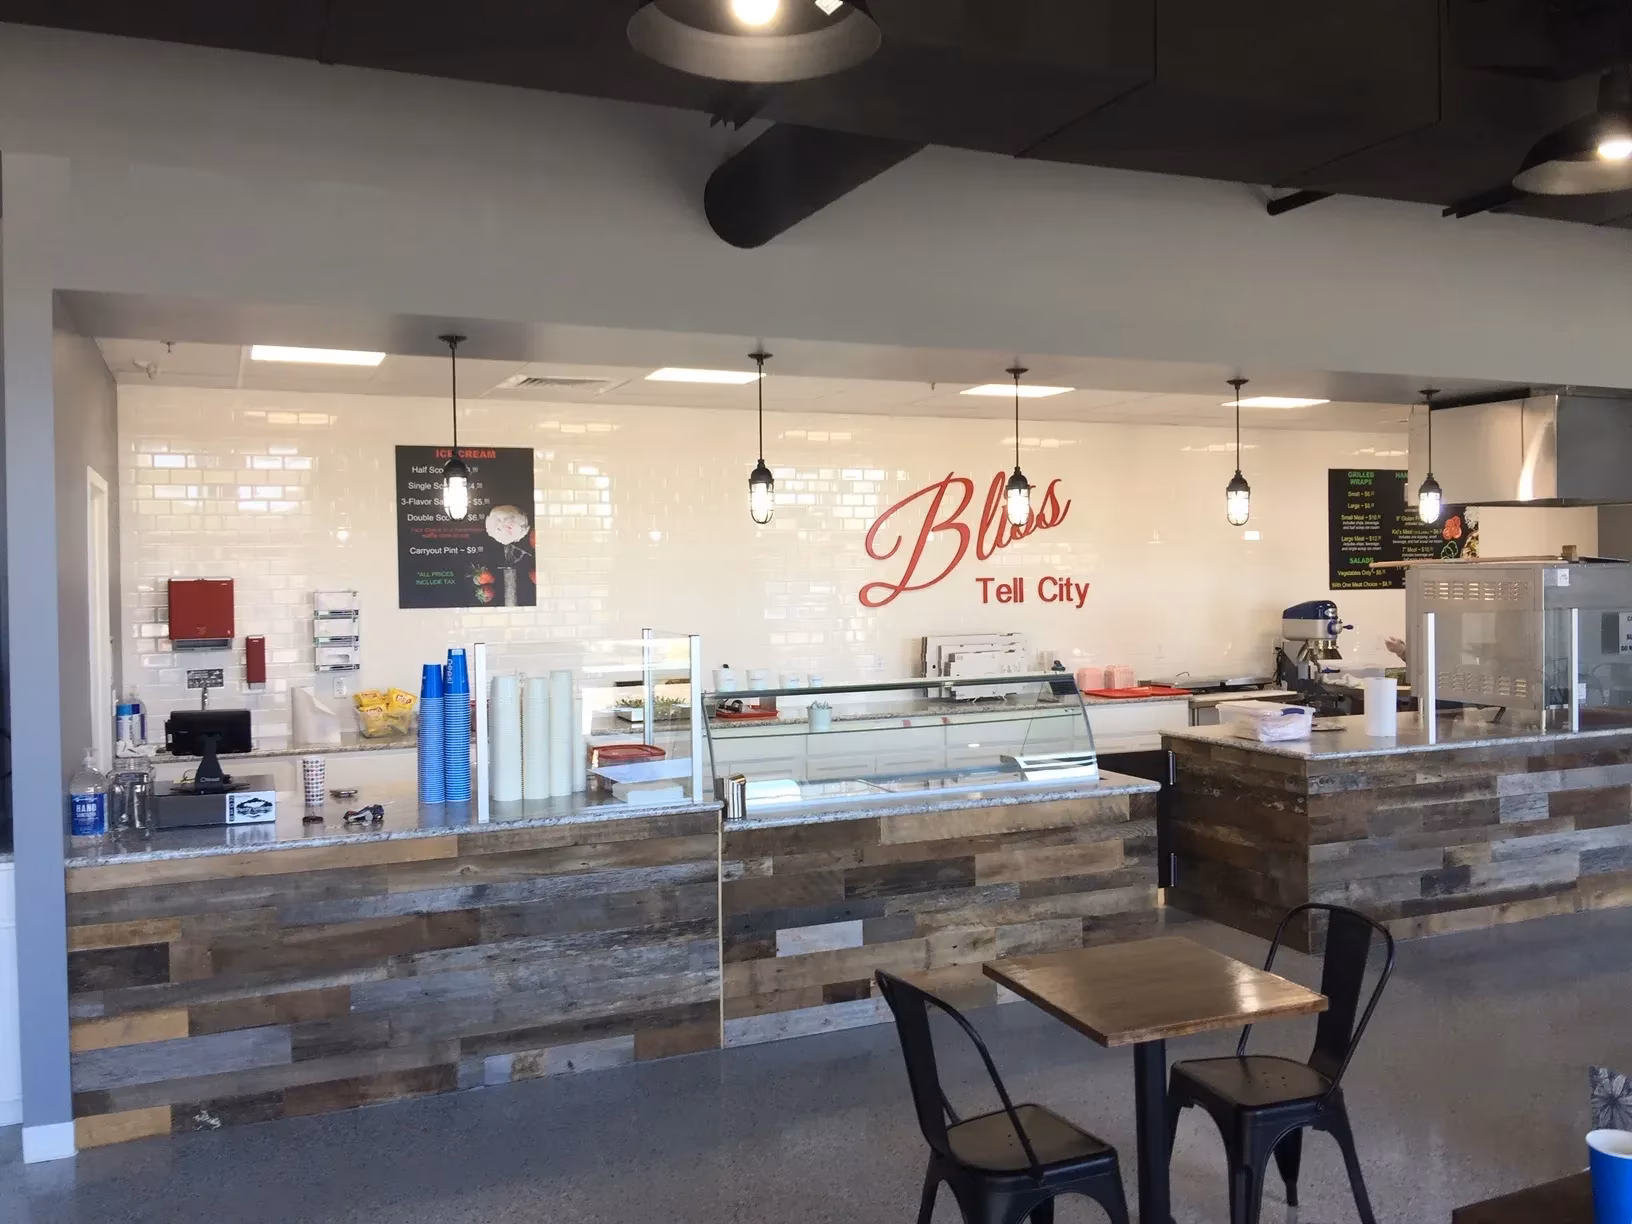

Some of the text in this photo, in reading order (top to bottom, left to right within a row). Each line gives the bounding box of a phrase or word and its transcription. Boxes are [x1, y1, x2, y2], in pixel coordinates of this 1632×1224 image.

[436, 449, 496, 459] ICE CREAM
[411, 465, 428, 474] Half
[408, 481, 432, 491] Single
[401, 498, 432, 506] 3-Flavor
[407, 513, 434, 522] Double
[409, 546, 442, 556] Carryout
[443, 546, 459, 554] Pint
[975, 576, 1090, 609] Tell City
[75, 803, 97, 813] HAND
